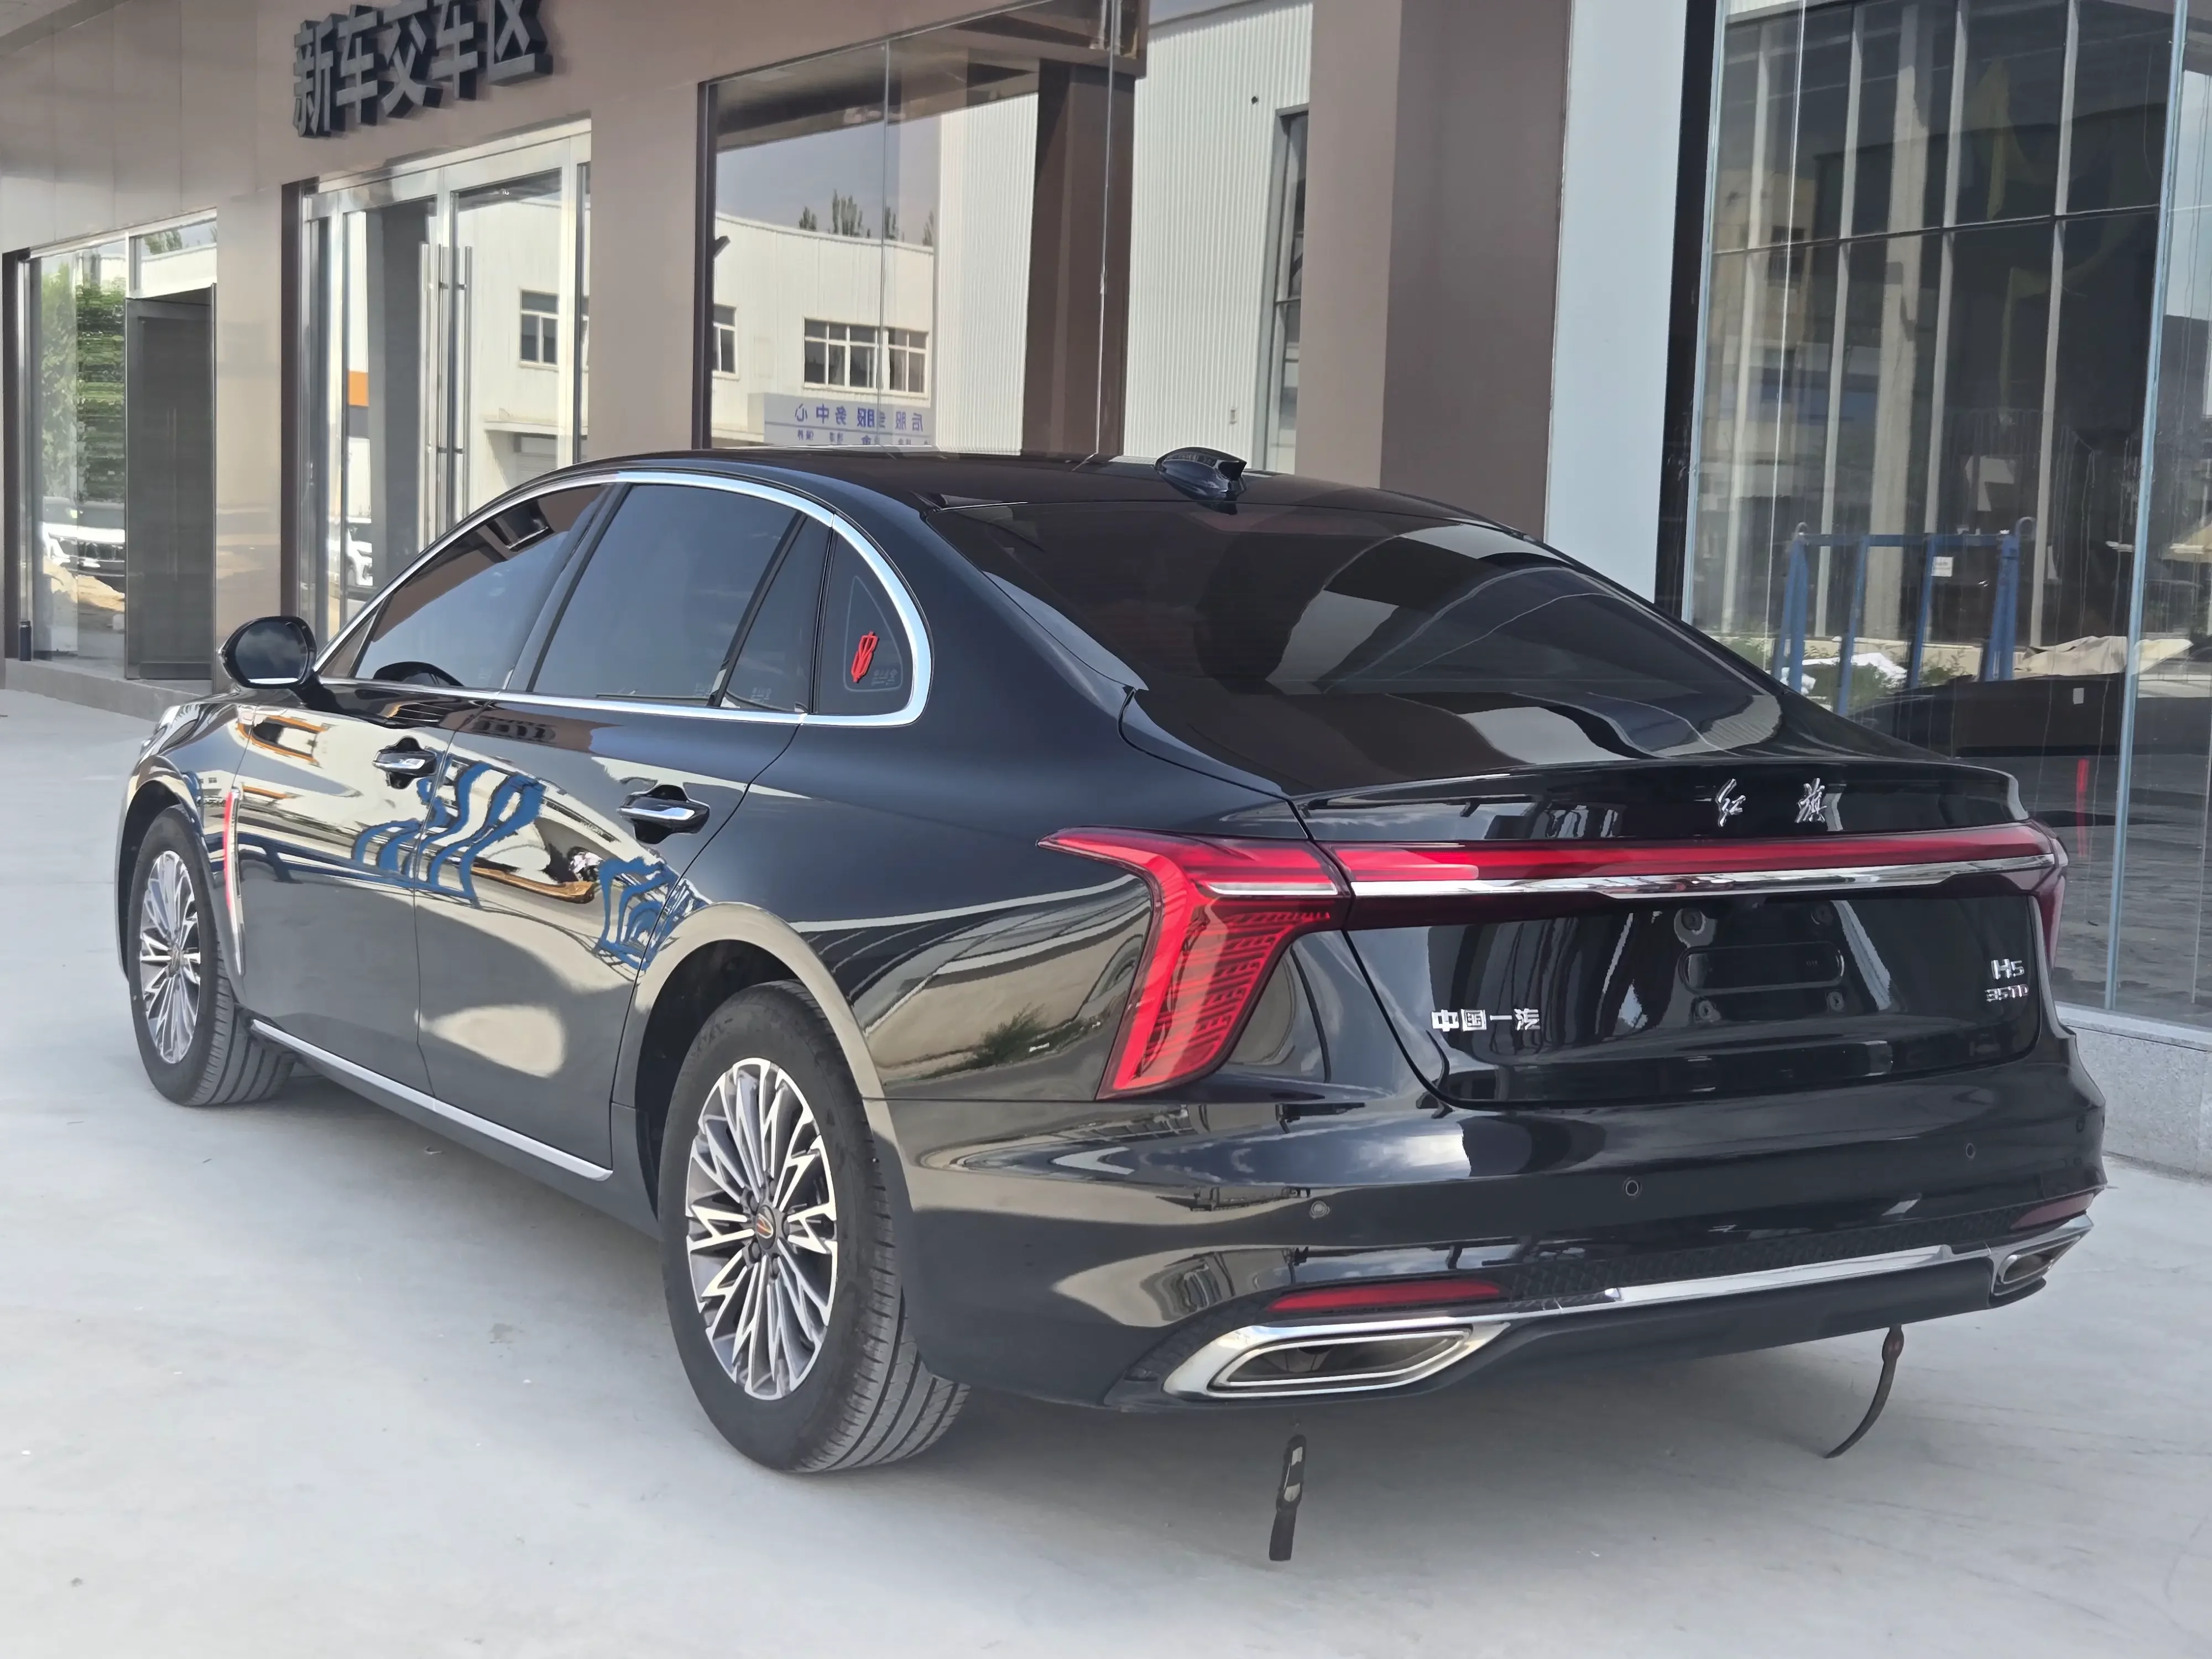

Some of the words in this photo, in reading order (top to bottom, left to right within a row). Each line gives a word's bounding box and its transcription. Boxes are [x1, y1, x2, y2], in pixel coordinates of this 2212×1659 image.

[293, 0, 551, 137] 新车交车区
[1991, 959, 2025, 979] H5
[1432, 1009, 1541, 1032] 中国一汽
